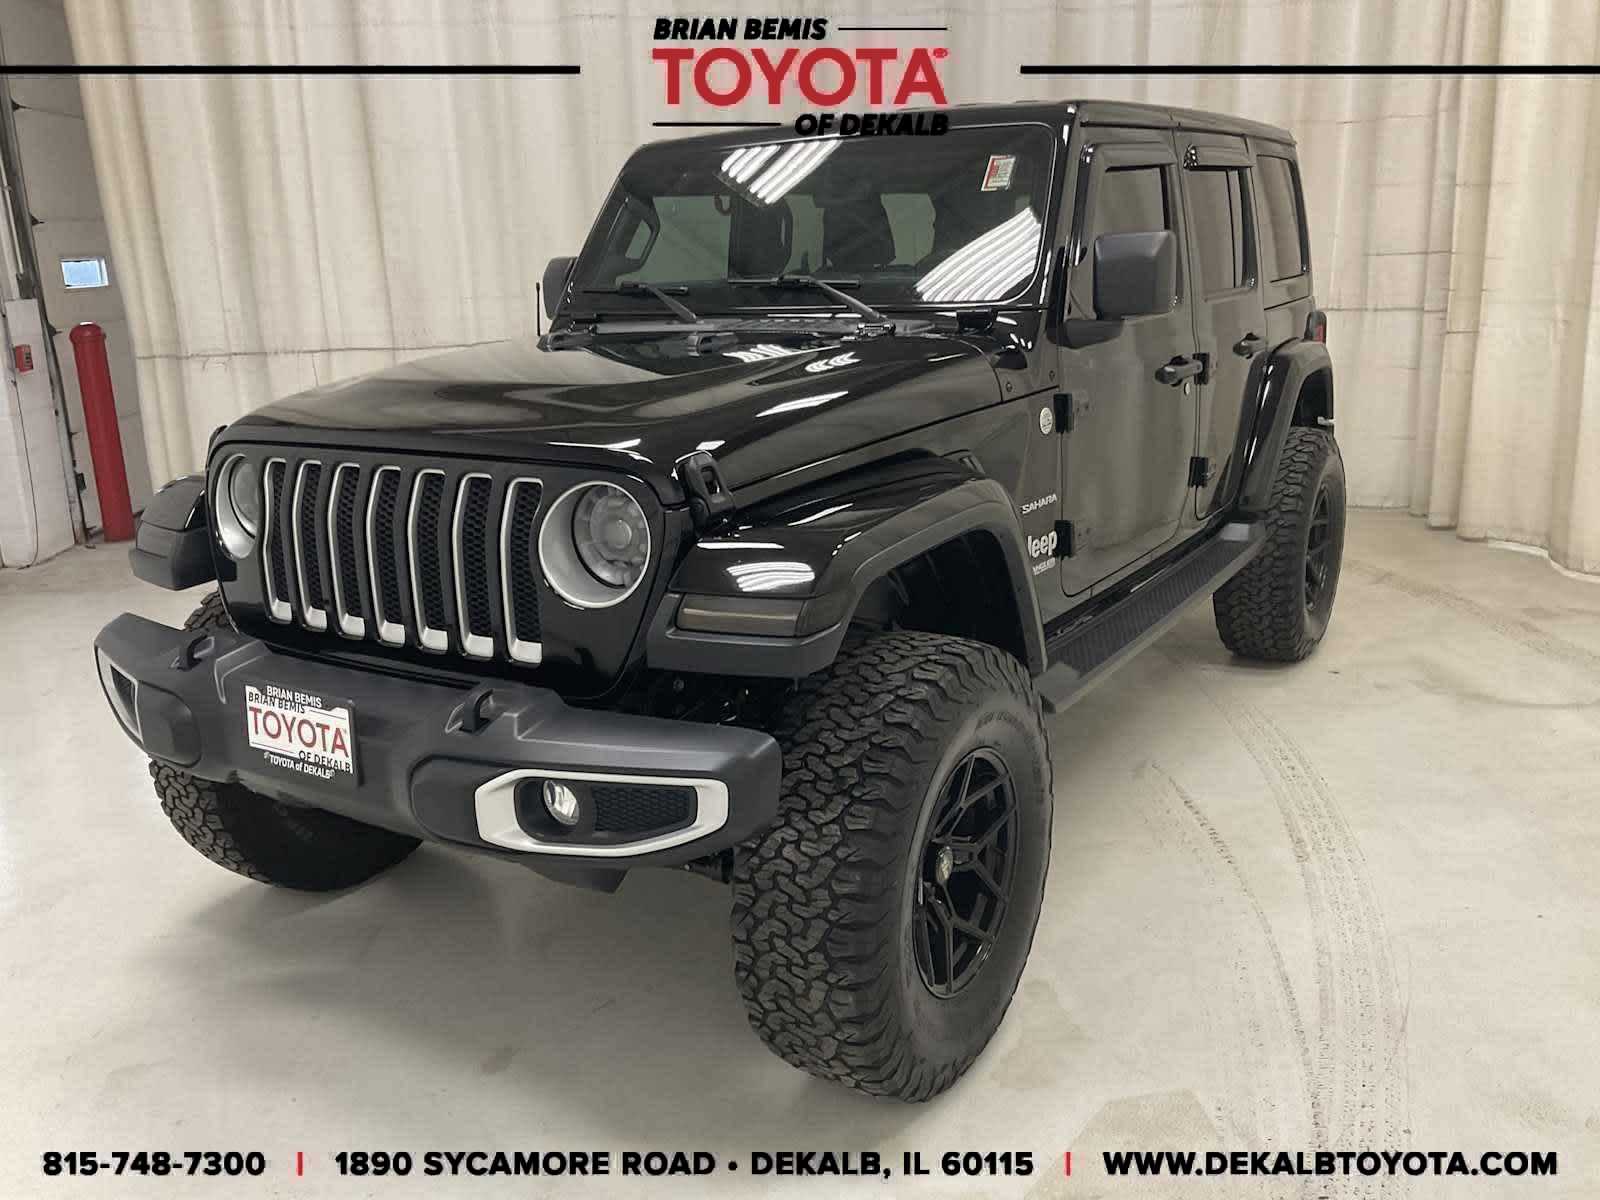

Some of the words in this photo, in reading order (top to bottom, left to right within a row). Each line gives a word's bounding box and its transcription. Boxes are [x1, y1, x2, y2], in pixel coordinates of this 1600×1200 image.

[1022, 493, 1058, 514] SAHARA
[248, 691, 276, 708] BRIAN
[278, 698, 305, 714] BEMIS
[266, 685, 294, 701] BRIAN
[294, 691, 322, 708] BEMIS
[249, 706, 349, 758] TOYOTA
[270, 754, 294, 769] TOYOTA
[295, 761, 302, 771] of
[303, 763, 331, 780] DEKALB
[299, 750, 312, 761] OF
[314, 754, 351, 772] DEKALB
